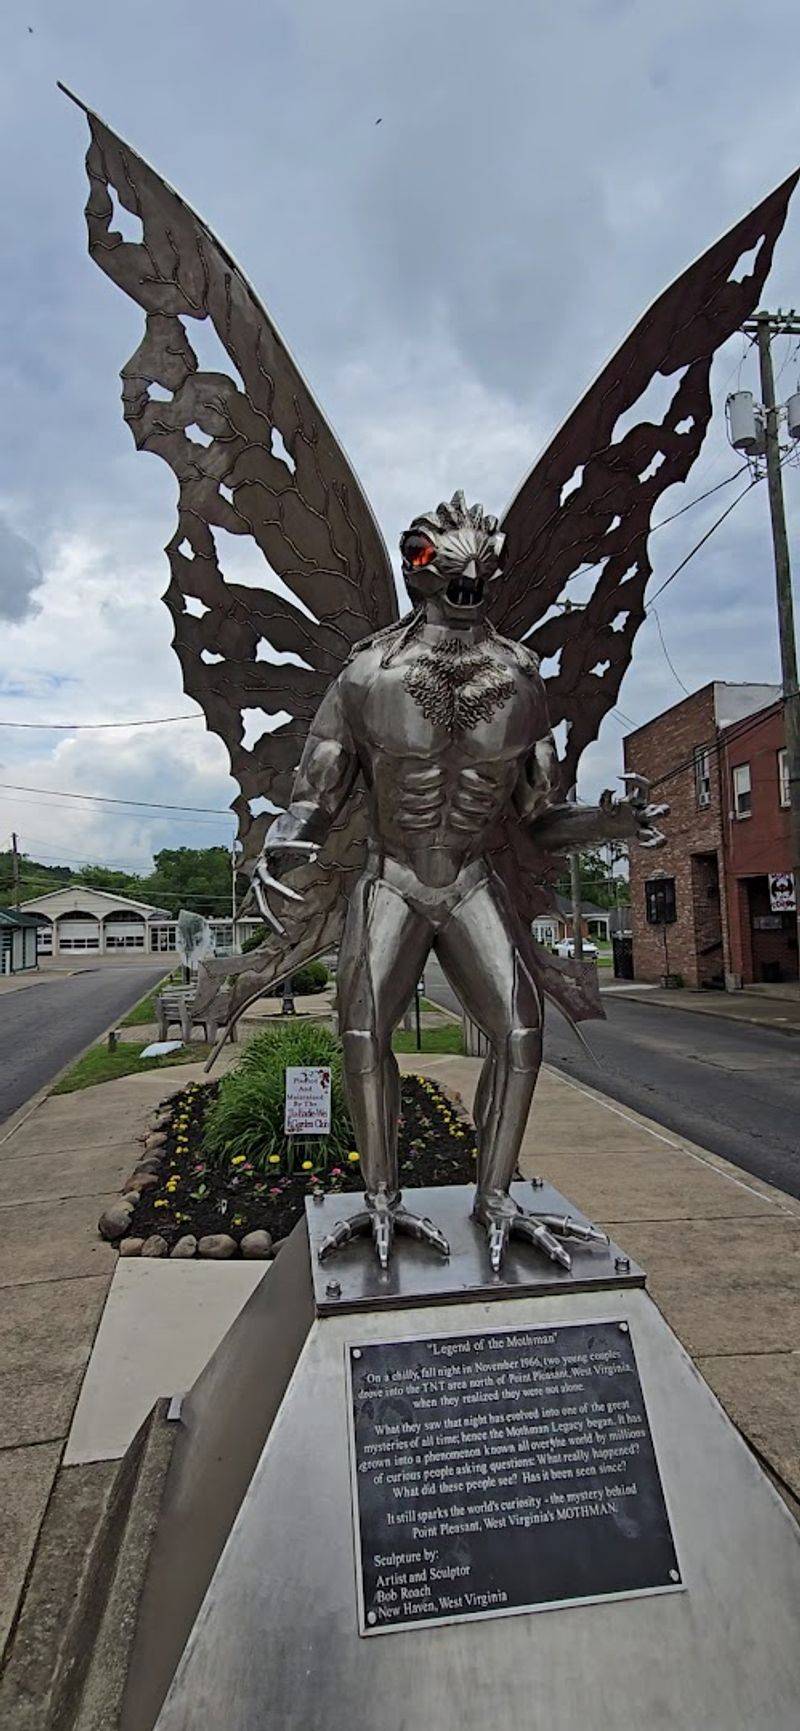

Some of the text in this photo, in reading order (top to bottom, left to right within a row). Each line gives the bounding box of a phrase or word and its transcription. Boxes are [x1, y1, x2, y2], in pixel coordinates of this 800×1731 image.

[426, 1332, 558, 1356] "Legend of the Mothman"
[367, 1373, 381, 1383] On
[392, 1369, 419, 1381] chilly,
[421, 1366, 436, 1378] fall
[438, 1366, 460, 1378] night
[462, 1364, 472, 1374] in
[475, 1360, 518, 1372] November
[544, 1356, 560, 1366] two
[562, 1354, 588, 1366] young
[590, 1350, 621, 1361] couples
[358, 1388, 382, 1400] drove
[385, 1386, 403, 1396] into
[406, 1384, 420, 1394] the
[422, 1381, 446, 1392] TNT
[448, 1383, 467, 1391] area
[470, 1376, 494, 1388] north
[496, 1375, 506, 1385] of
[509, 1373, 531, 1384] Point
[572, 1367, 592, 1377] West
[412, 1382, 584, 1409] when they realized they were not alone.
[374, 1400, 630, 1435] What they saw that night has evolved into one of the great
[360, 1429, 646, 1472] grown into a phenomenon known all over the world by millions
[364, 1440, 409, 1455] mysteries
[410, 1437, 419, 1448] of
[422, 1436, 434, 1447] all
[461, 1431, 487, 1442] hence
[489, 1428, 504, 1439] the
[506, 1424, 549, 1437] Mothman
[552, 1421, 583, 1434] Legacy
[586, 1418, 616, 1429] began.
[618, 1414, 625, 1424] It
[627, 1414, 642, 1423] has
[373, 1473, 384, 1484] of
[386, 1470, 420, 1483] curious
[424, 1465, 454, 1481] people
[456, 1462, 487, 1475] asking
[536, 1454, 562, 1465] What
[564, 1450, 590, 1462] really
[592, 1443, 640, 1459] happened?
[393, 1461, 627, 1498] What did these people see? Has it been seen since?
[387, 1513, 395, 1525] It
[396, 1510, 416, 1524] still
[417, 1507, 448, 1523] sparks
[450, 1505, 465, 1516] the
[466, 1500, 499, 1514] world's
[501, 1496, 541, 1510] curiosity
[550, 1492, 564, 1504] the
[566, 1490, 603, 1503] mystery
[605, 1483, 637, 1497] behind
[412, 1526, 437, 1539] Point
[440, 1521, 482, 1535] Pleasant,
[483, 1517, 506, 1529] West
[508, 1510, 554, 1527] Virginia's
[374, 1548, 439, 1567] Sculpture by:
[376, 1565, 471, 1588] Artist and Sculptor
[376, 1584, 431, 1603] Bob Roach
[378, 1589, 508, 1618] New Haven, West Virginia
